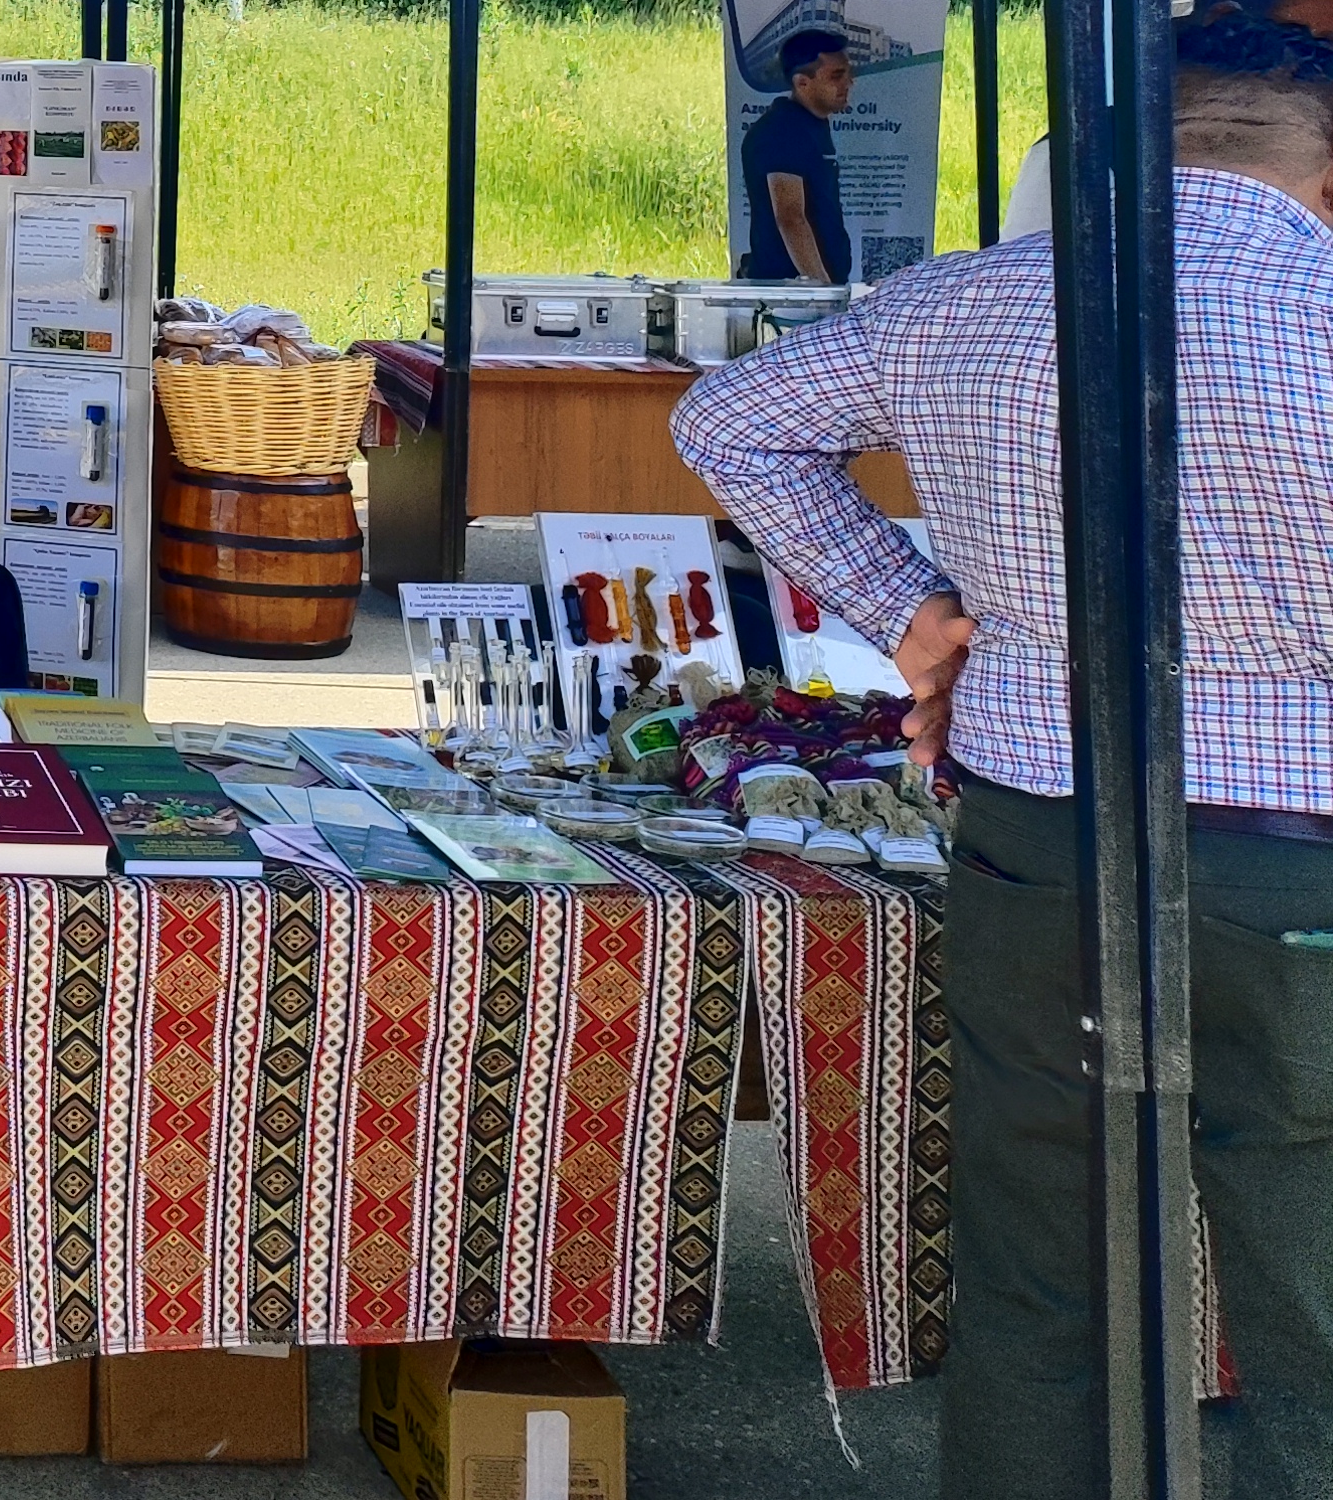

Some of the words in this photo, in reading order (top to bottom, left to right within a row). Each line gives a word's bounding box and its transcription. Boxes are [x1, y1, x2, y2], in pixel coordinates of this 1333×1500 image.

[857, 102, 877, 114] Oil
[833, 119, 902, 134] University
[632, 533, 676, 542] BOYALARI
